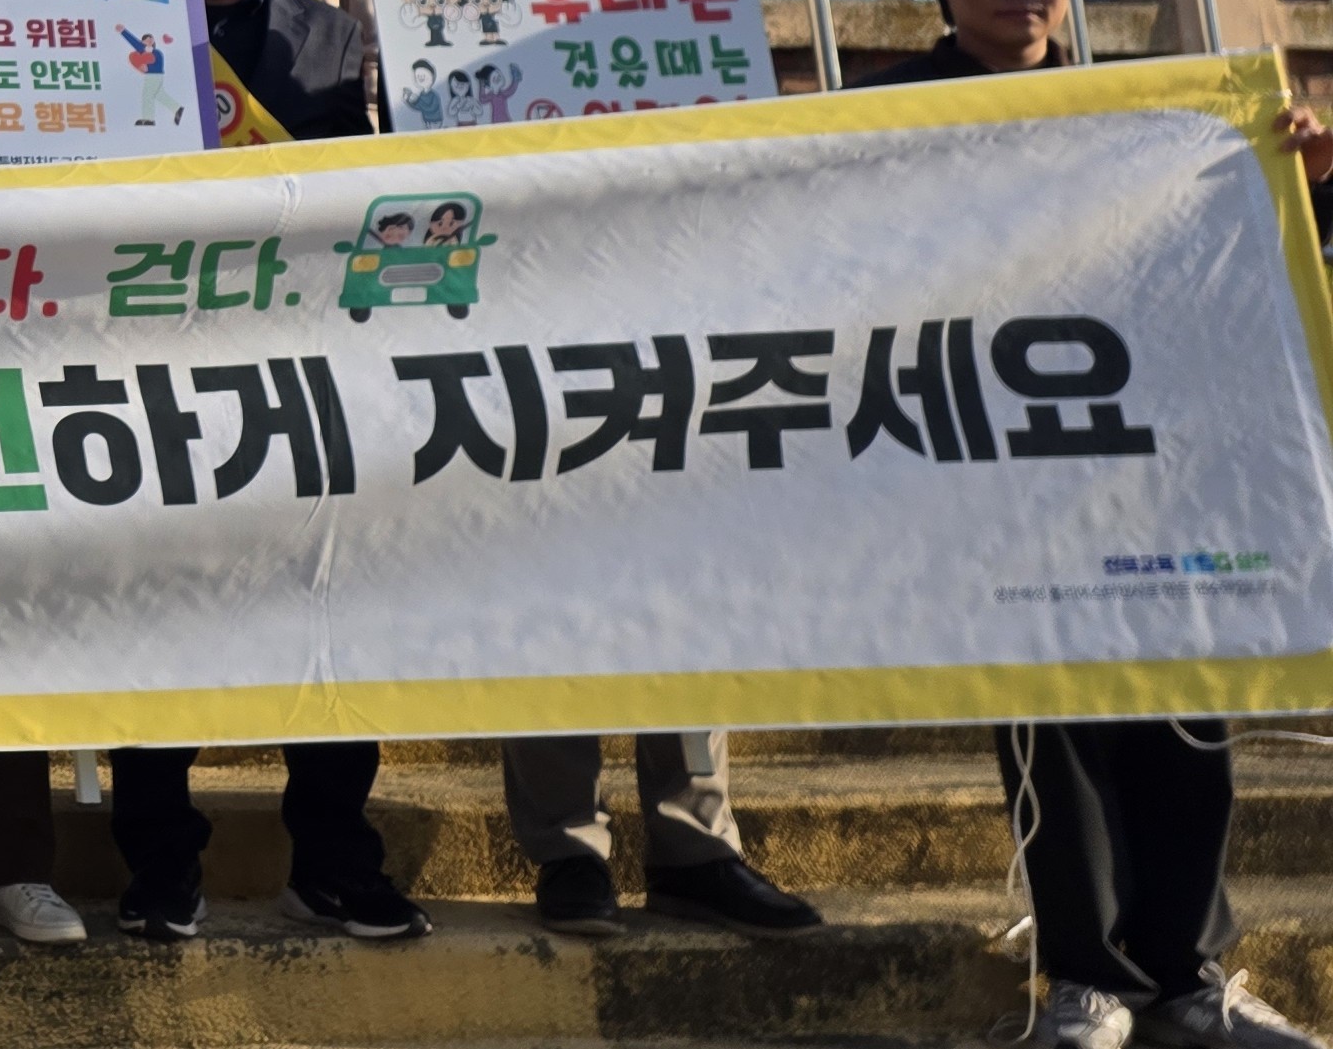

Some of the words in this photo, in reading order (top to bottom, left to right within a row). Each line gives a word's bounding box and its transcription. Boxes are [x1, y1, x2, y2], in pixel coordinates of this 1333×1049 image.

[26, 18, 97, 49] 위험!
[30, 60, 101, 91] 안전!
[34, 102, 106, 134] 행복!
[105, 237, 301, 318] 걷다.
[396, 313, 1156, 486] 지켜주세요
